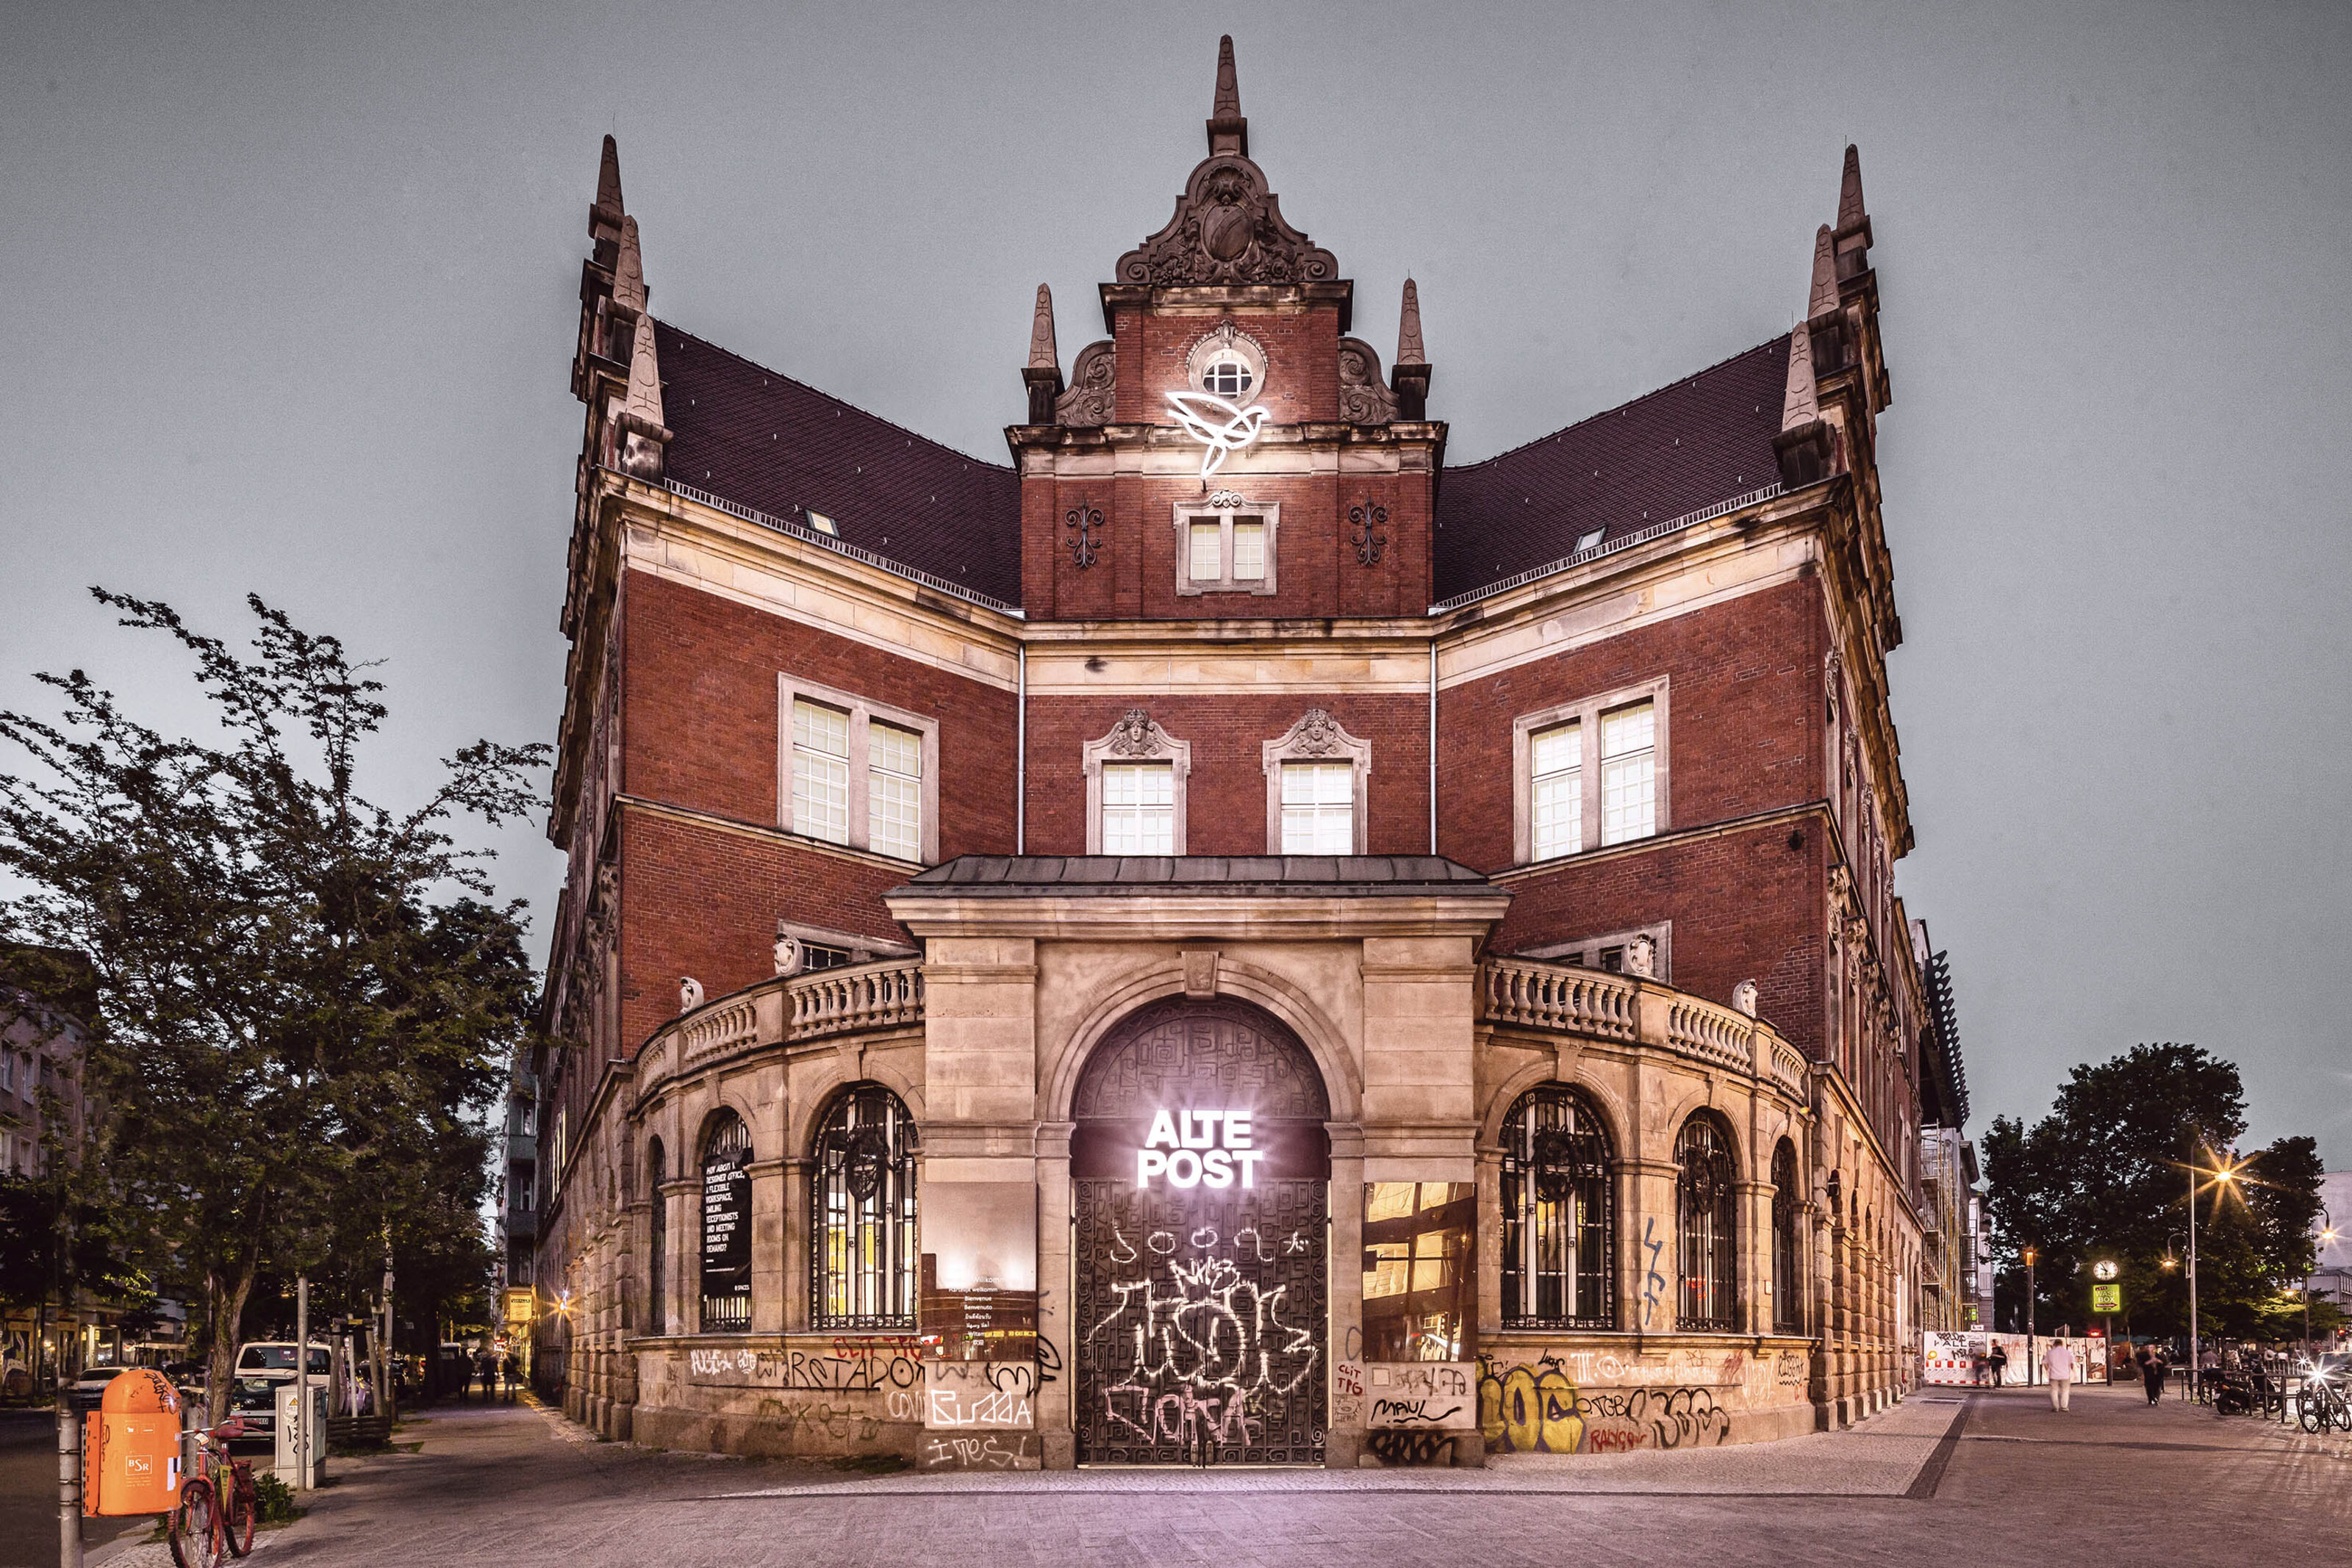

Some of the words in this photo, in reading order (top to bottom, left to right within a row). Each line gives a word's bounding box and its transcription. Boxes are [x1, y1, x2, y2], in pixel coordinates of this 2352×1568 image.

[1145, 1110, 1252, 1148] ALTE
[1137, 1149, 1263, 1189] POST
[709, 1182, 730, 1193] FLEXIBLE
[716, 1222, 735, 1232] MEETING
[722, 1233, 729, 1242] ON
[1371, 1399, 1462, 1422] MAUL
[129, 1459, 149, 1472] BSR
